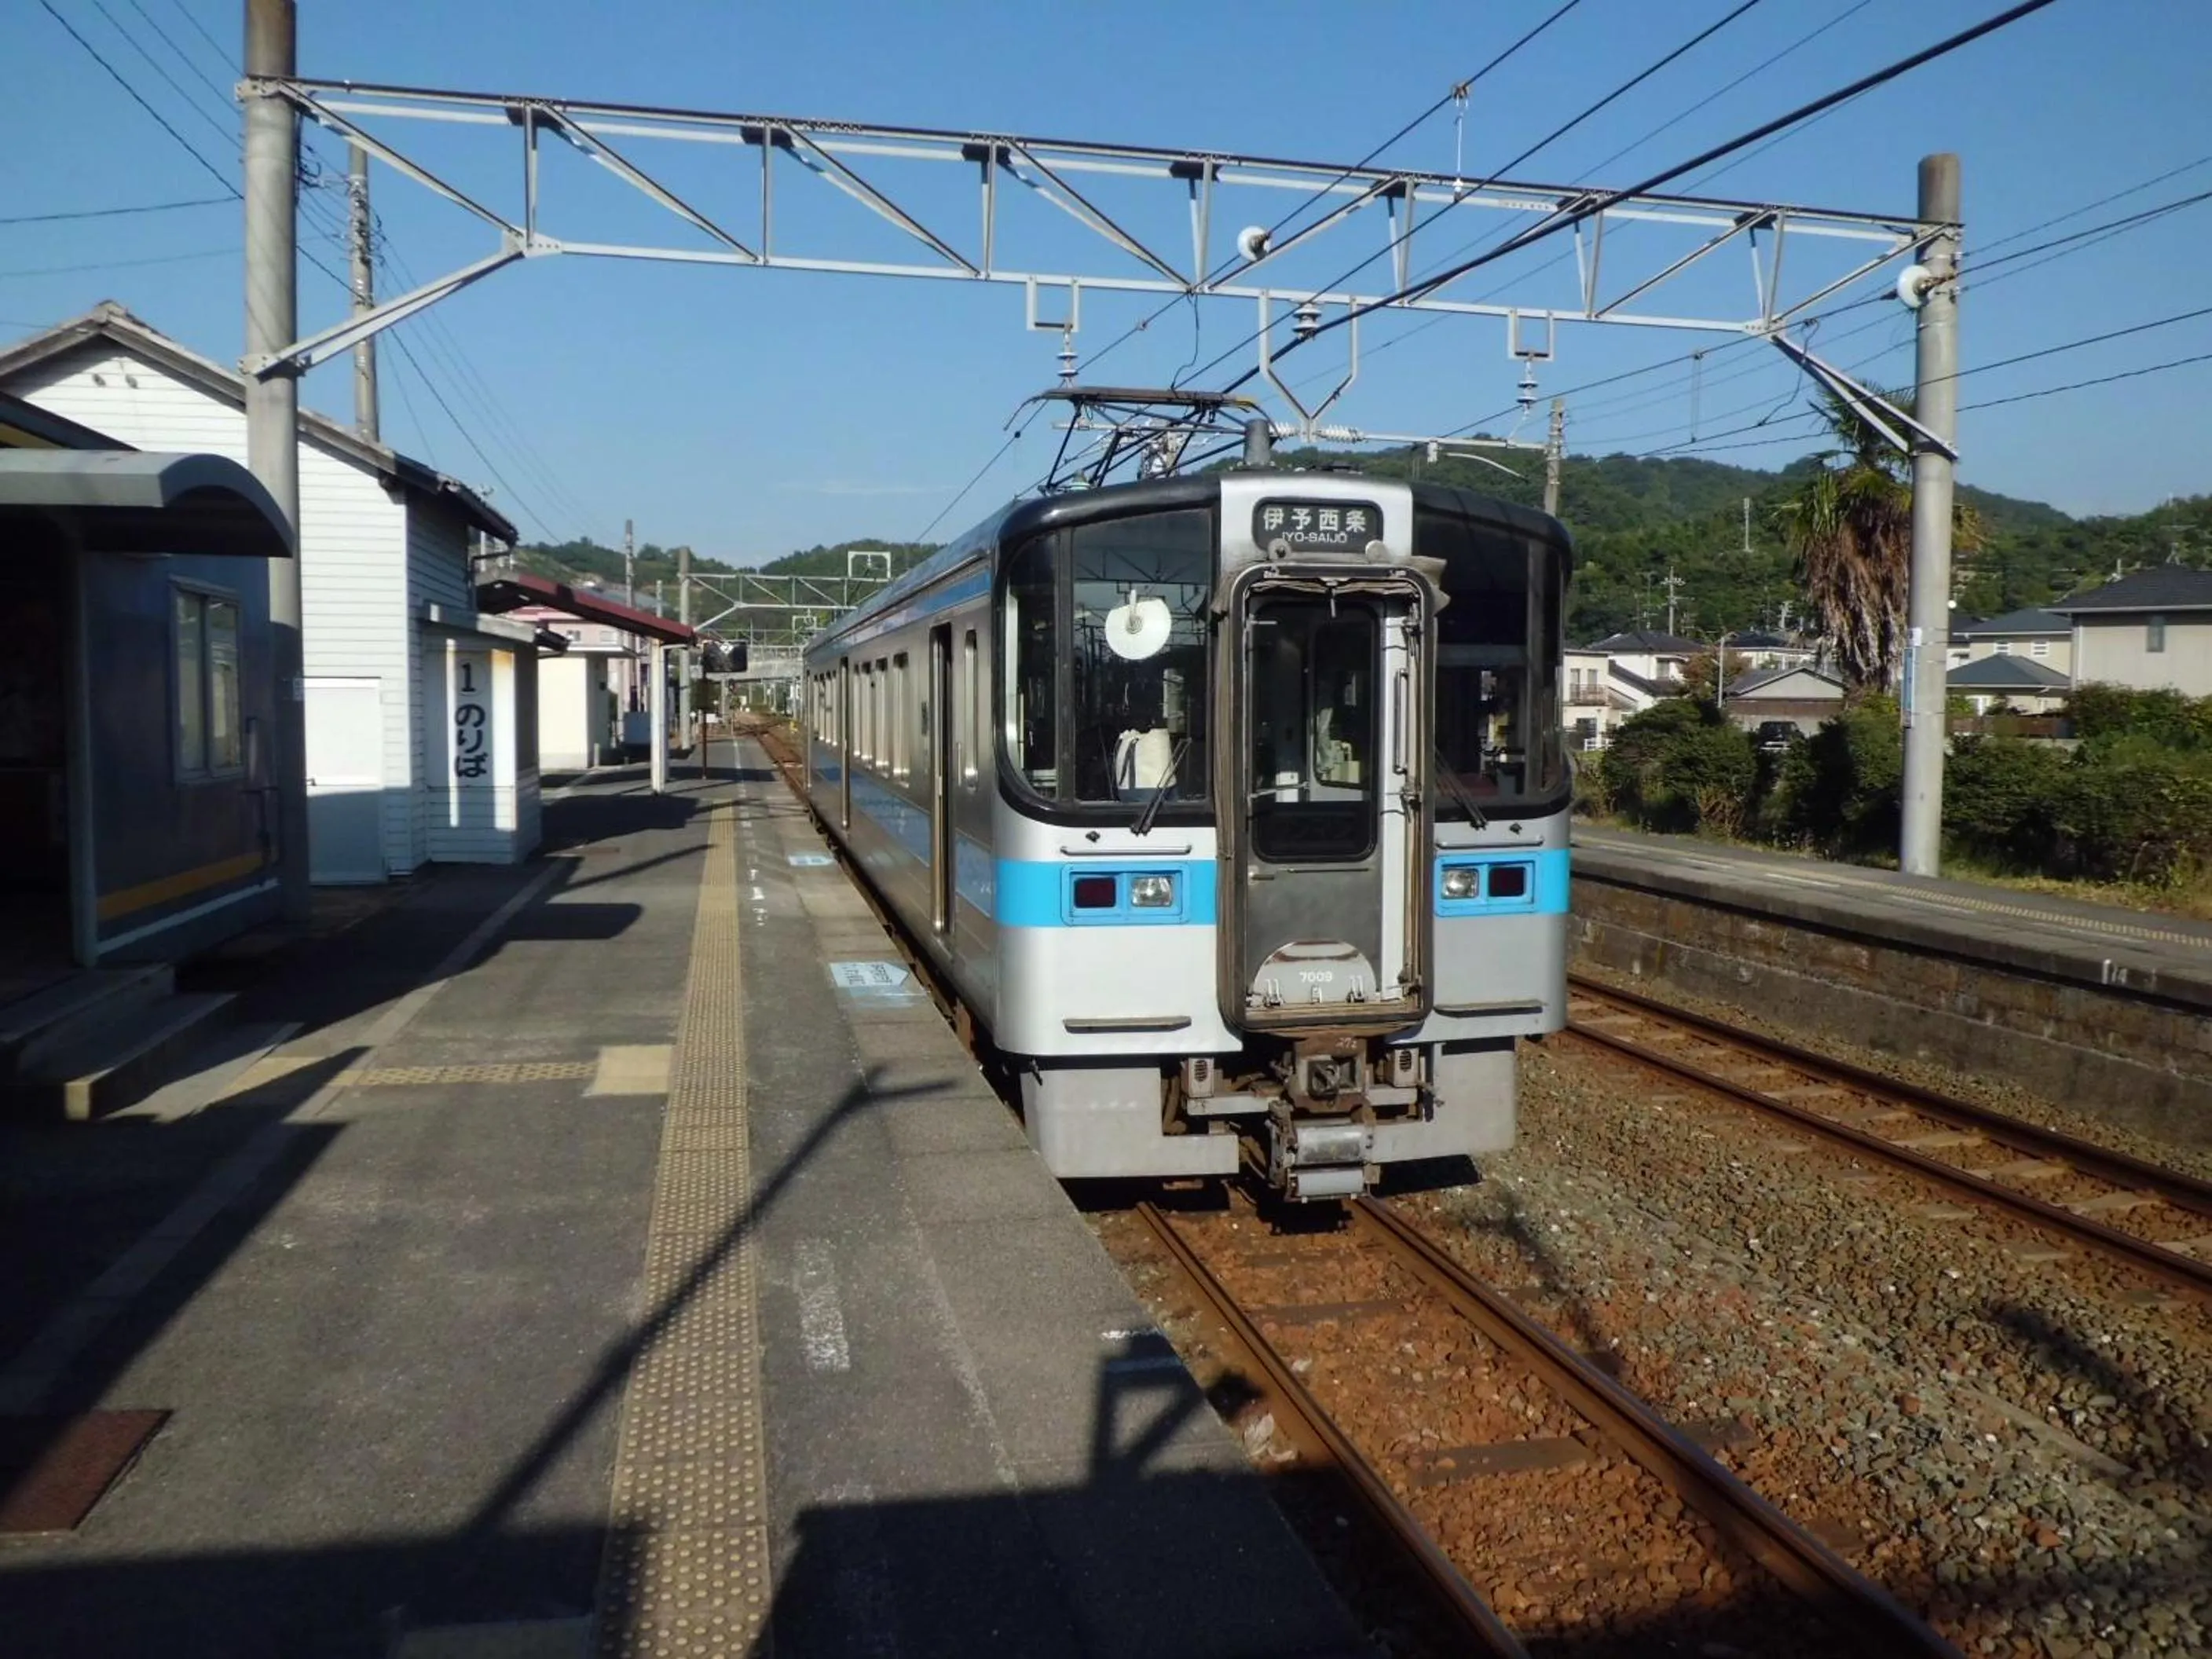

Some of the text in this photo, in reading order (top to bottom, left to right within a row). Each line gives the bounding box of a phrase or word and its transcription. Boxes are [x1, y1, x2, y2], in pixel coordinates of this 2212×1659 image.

[1263, 507, 1366, 533] 伊予西条
[1298, 971, 1333, 983] 7009
